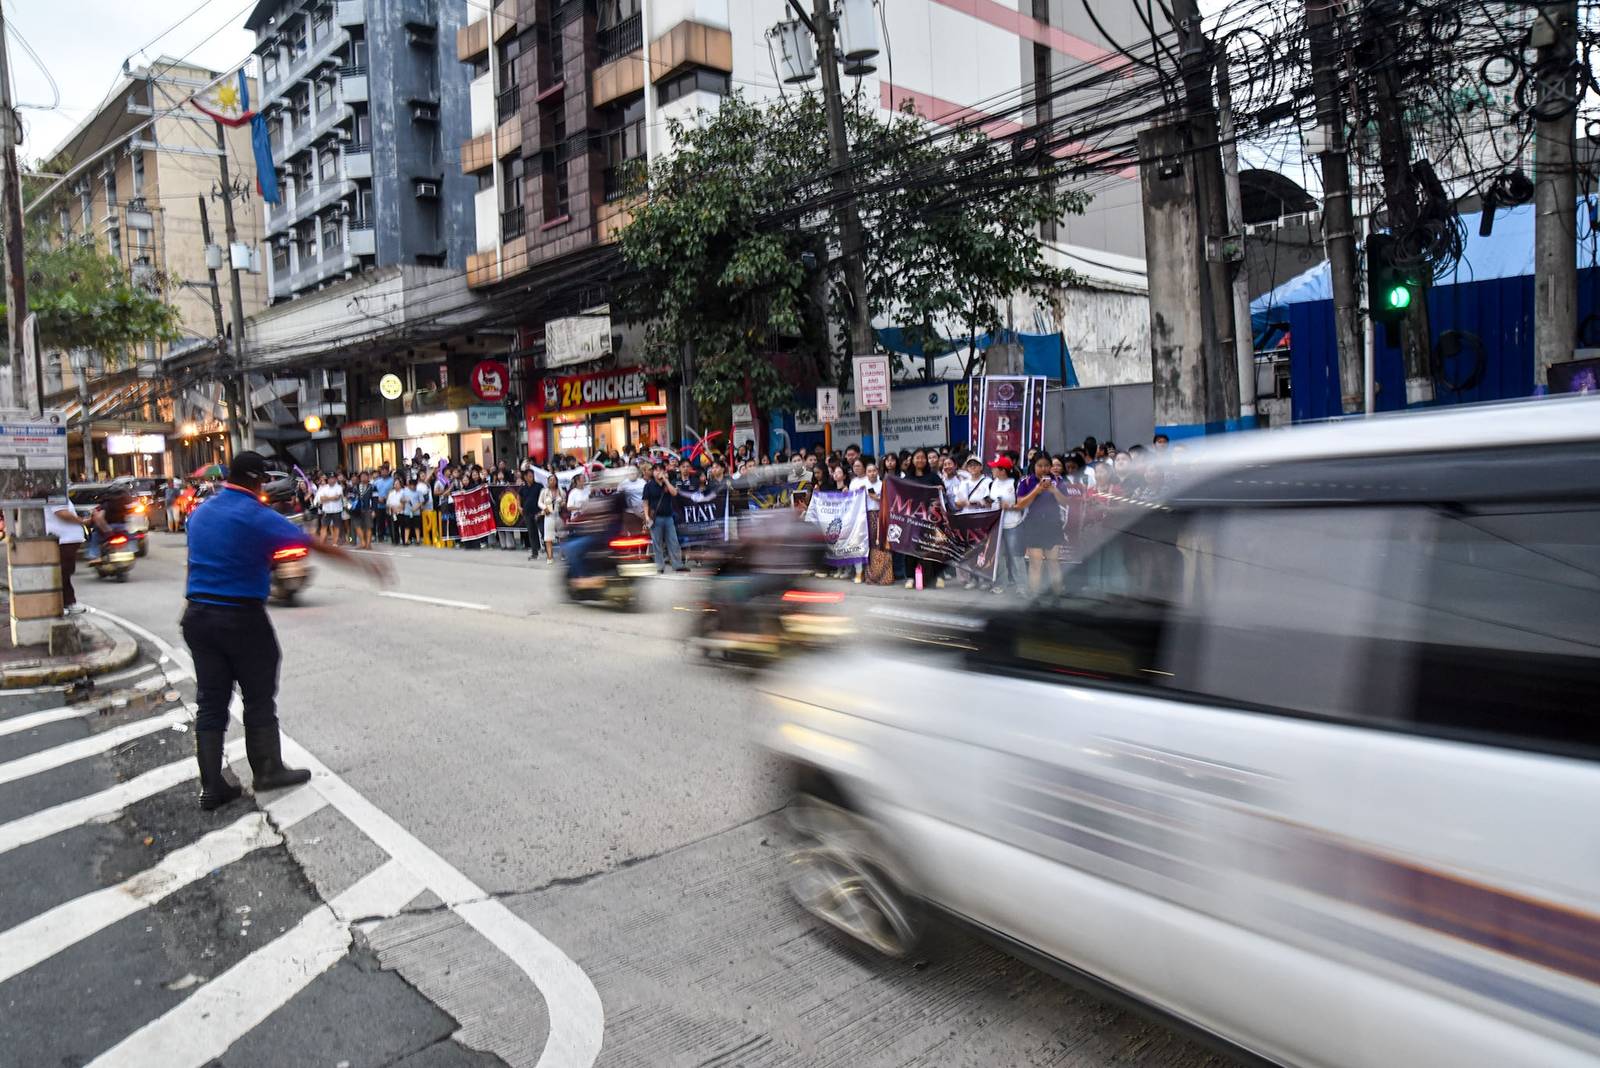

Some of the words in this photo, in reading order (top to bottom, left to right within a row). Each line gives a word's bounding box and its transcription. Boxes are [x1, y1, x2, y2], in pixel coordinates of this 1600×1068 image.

[562, 380, 582, 407] 24
[583, 372, 647, 403] CHICKEN
[683, 502, 716, 523] FIAT
